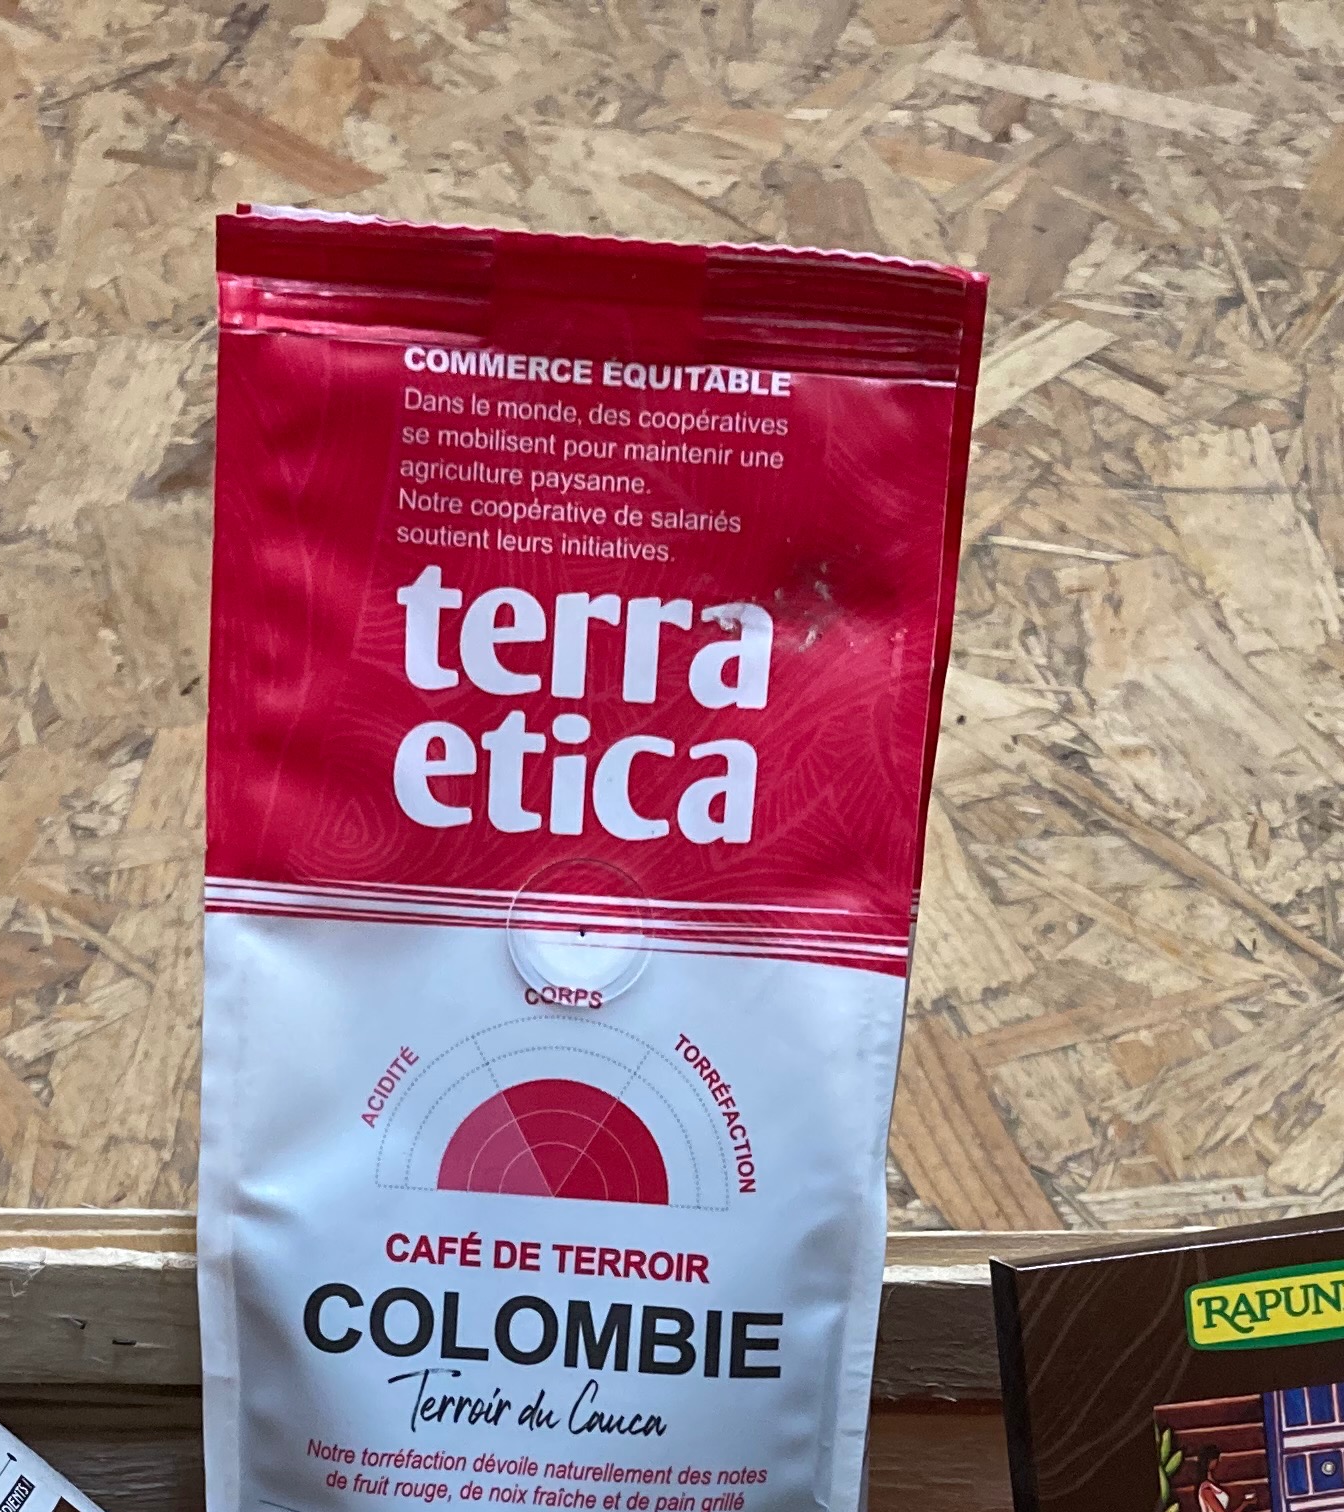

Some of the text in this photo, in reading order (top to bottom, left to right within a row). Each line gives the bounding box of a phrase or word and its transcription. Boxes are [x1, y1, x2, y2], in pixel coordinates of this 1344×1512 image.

[404, 346, 791, 397] COMMERCE ÉQUITABLE
[404, 387, 789, 436] Dans le monde, des coopératives
[402, 426, 785, 470] se mobilisent pour maintenir une
[400, 458, 652, 496] agriculture paysanne.
[398, 487, 741, 533] Notre coopérative de salariés
[396, 524, 676, 563] soutient leurs initiatives.
[396, 564, 774, 710] terra
[393, 710, 758, 845] etica
[524, 985, 603, 1010] CORPS
[360, 1045, 420, 1129] ACIDITÉ
[674, 1033, 757, 1194] TORRÉFACTION
[385, 1232, 710, 1285] CAFÉ DE TERROIR
[303, 1282, 785, 1380] COLOMBIE
[388, 1368, 668, 1438] Terroir du Cauca
[307, 1438, 767, 1485] Notre torréfaction dévoile naturellement des notes
[326, 1470, 348, 1490] de
[353, 1474, 388, 1496] fruit
[394, 1482, 452, 1502] rouge,
[460, 1481, 483, 1500] de
[489, 1485, 527, 1504] noix
[532, 1486, 597, 1510] fraîche
[603, 1491, 623, 1510] et
[627, 1491, 649, 1511] de
